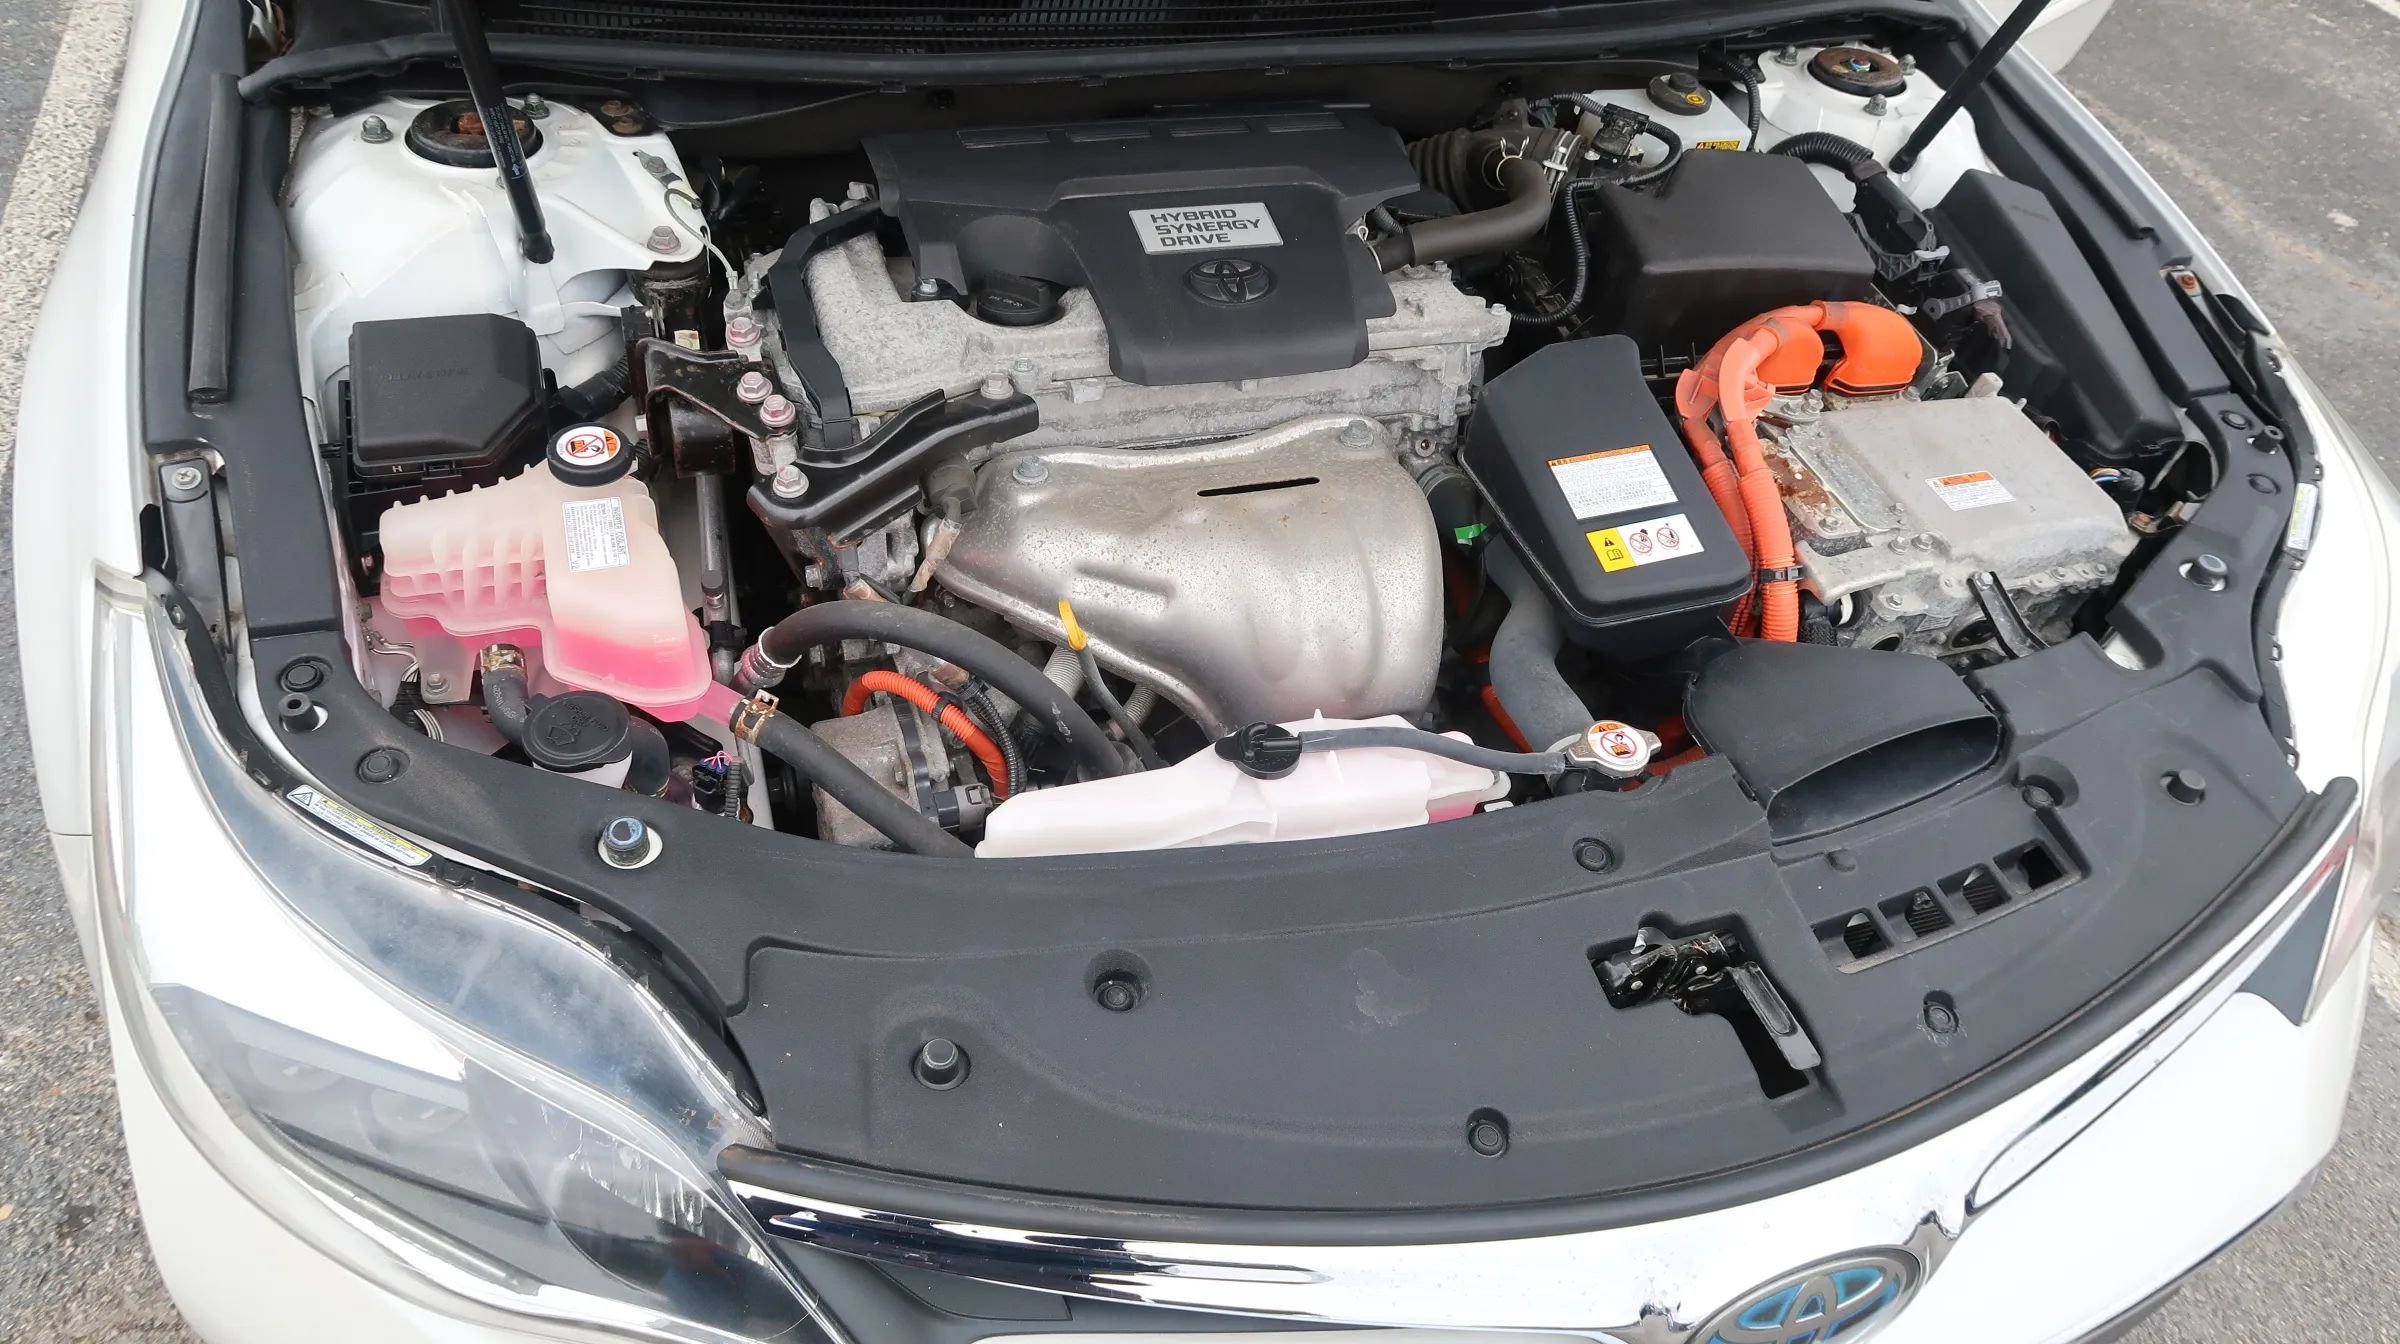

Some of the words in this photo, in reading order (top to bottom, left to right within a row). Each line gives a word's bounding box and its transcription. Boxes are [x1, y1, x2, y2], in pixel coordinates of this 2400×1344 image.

[1150, 209, 1237, 223] HYBRID
[1155, 219, 1261, 235] SYNERGY
[1160, 233, 1231, 247] DRIVE
[391, 465, 403, 473] H
